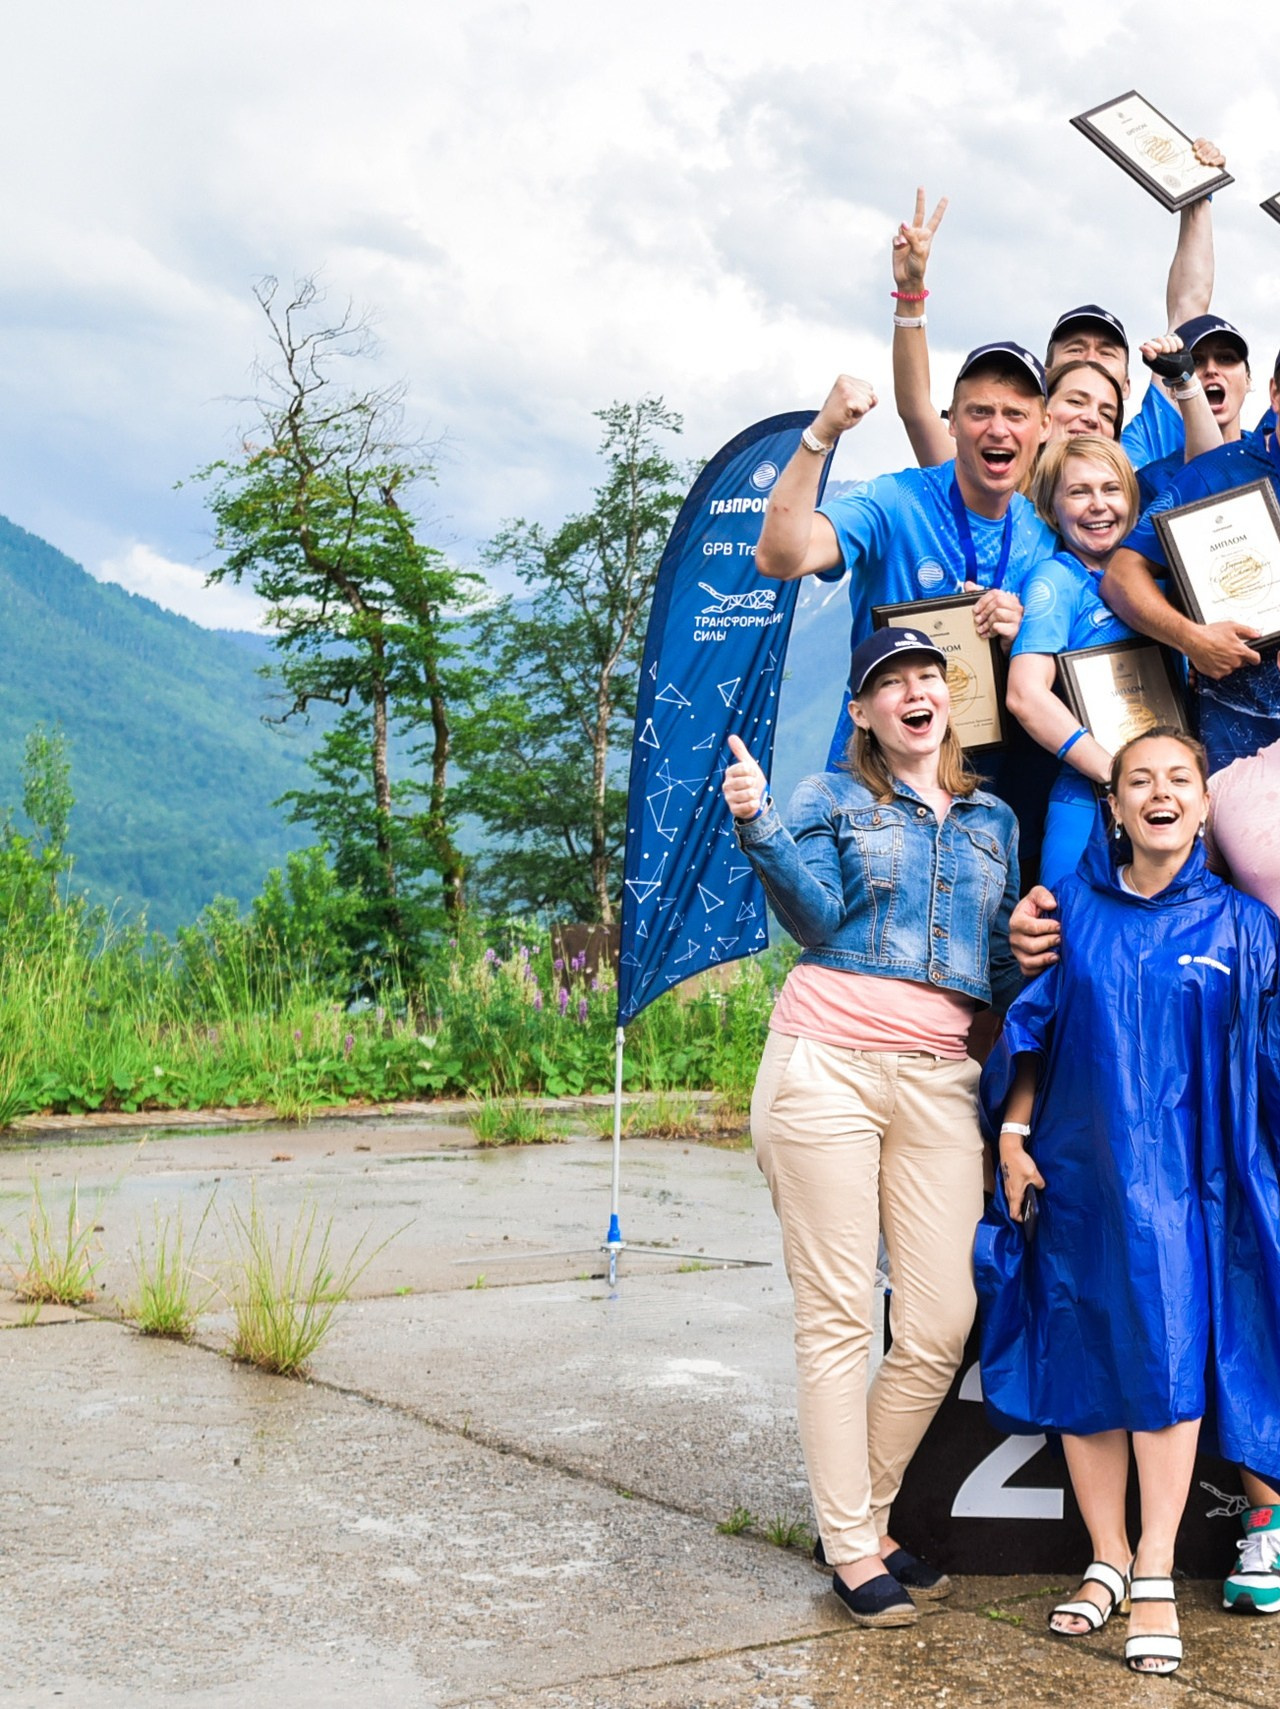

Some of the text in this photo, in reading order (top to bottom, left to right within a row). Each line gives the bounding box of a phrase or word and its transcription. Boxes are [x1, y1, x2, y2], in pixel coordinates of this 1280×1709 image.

[702, 542, 733, 556] GPB
[1209, 534, 1248, 552] ДИПЛОМ
[693, 630, 727, 642] СИЛЫ
